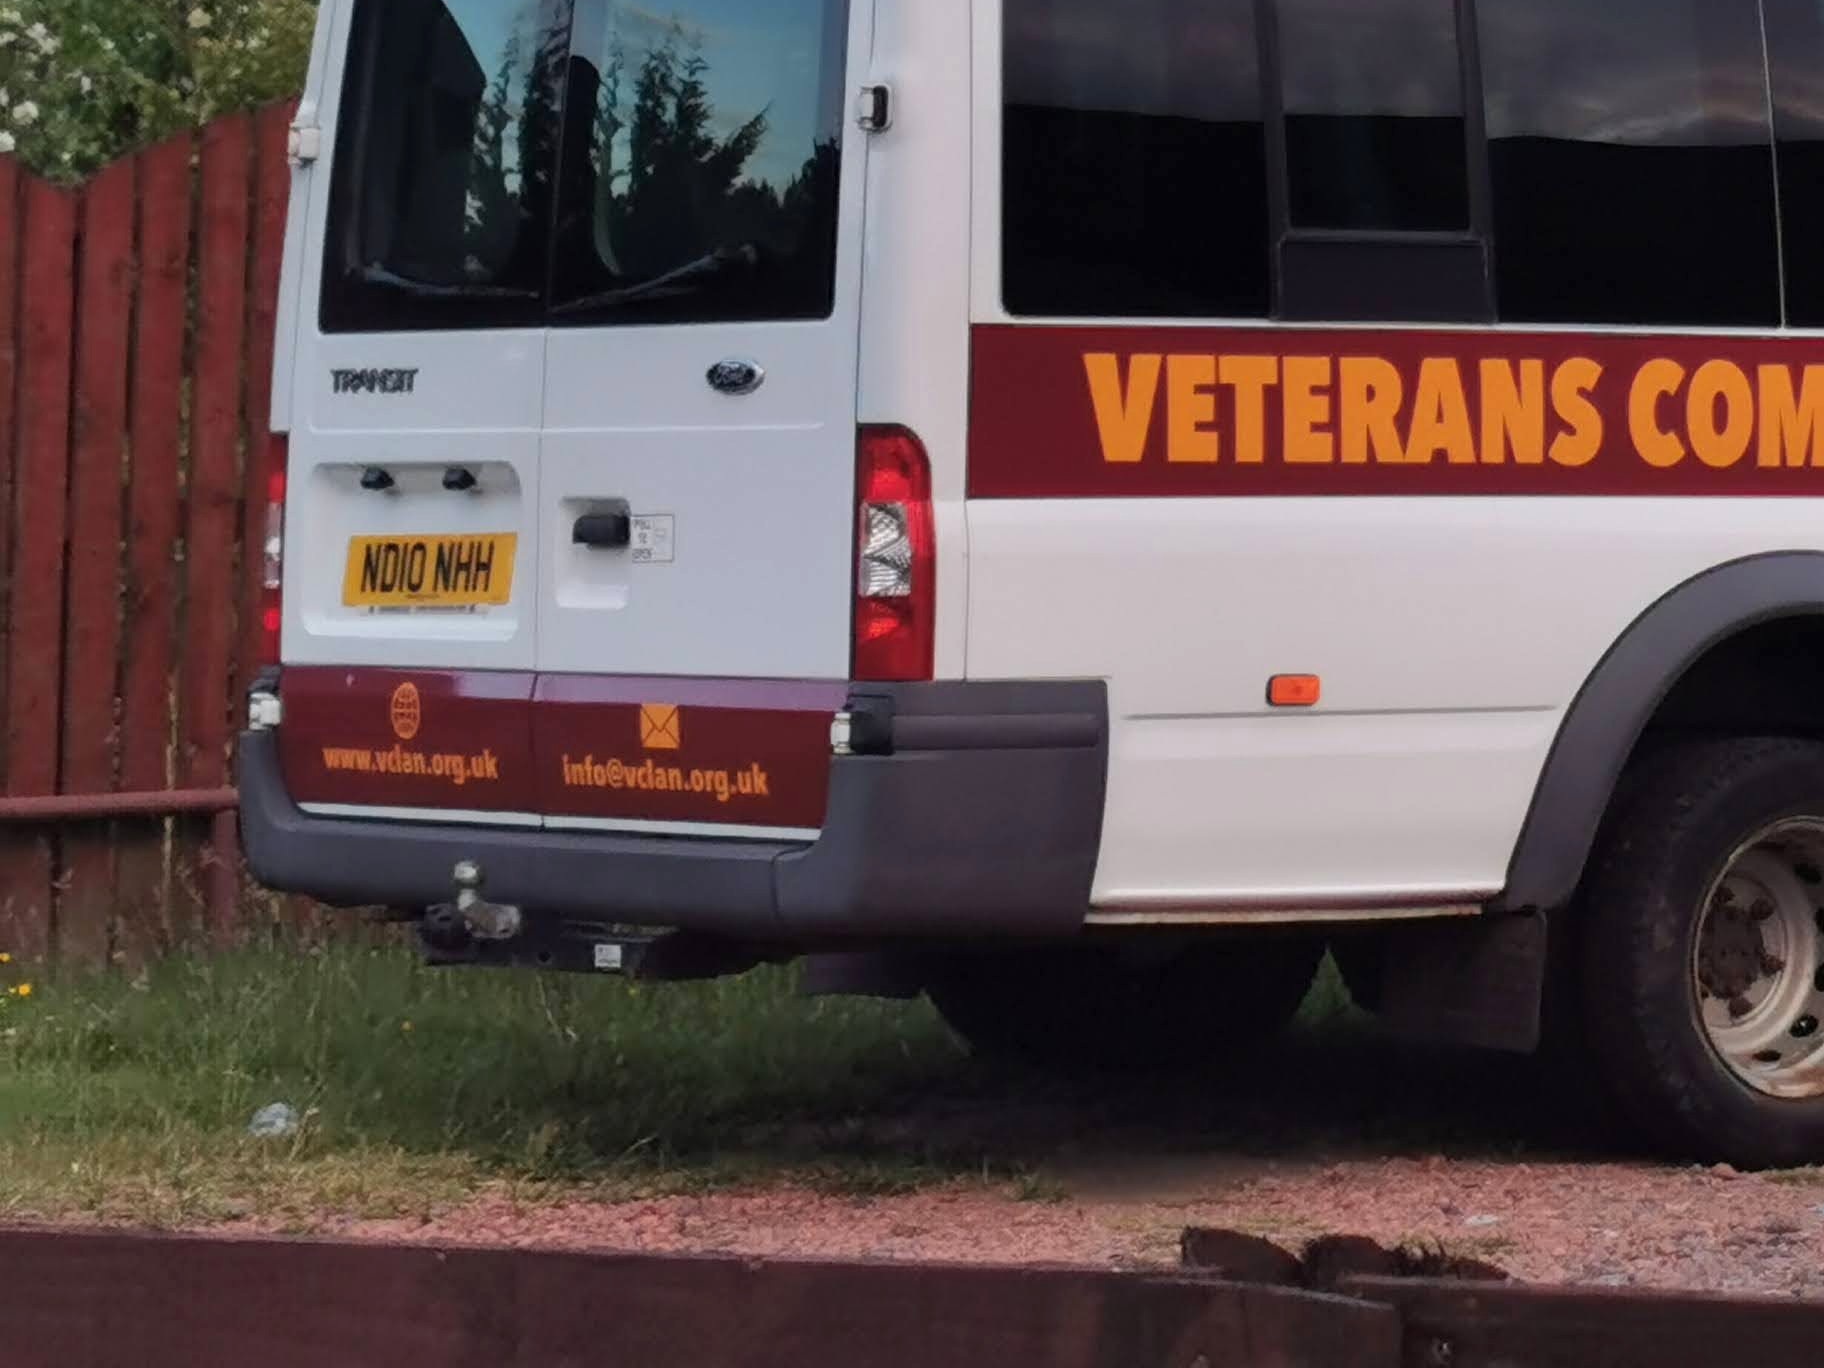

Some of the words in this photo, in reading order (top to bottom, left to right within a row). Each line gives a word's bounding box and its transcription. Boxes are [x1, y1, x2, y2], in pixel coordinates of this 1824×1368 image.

[330, 368, 418, 393] TRANSIT
[1083, 353, 1604, 468] VETERANS
[361, 541, 428, 594] ND10
[433, 540, 495, 592] NHH
[323, 746, 498, 785] www.vclan.org.uk
[562, 753, 769, 802] info@vclan.org.uk
